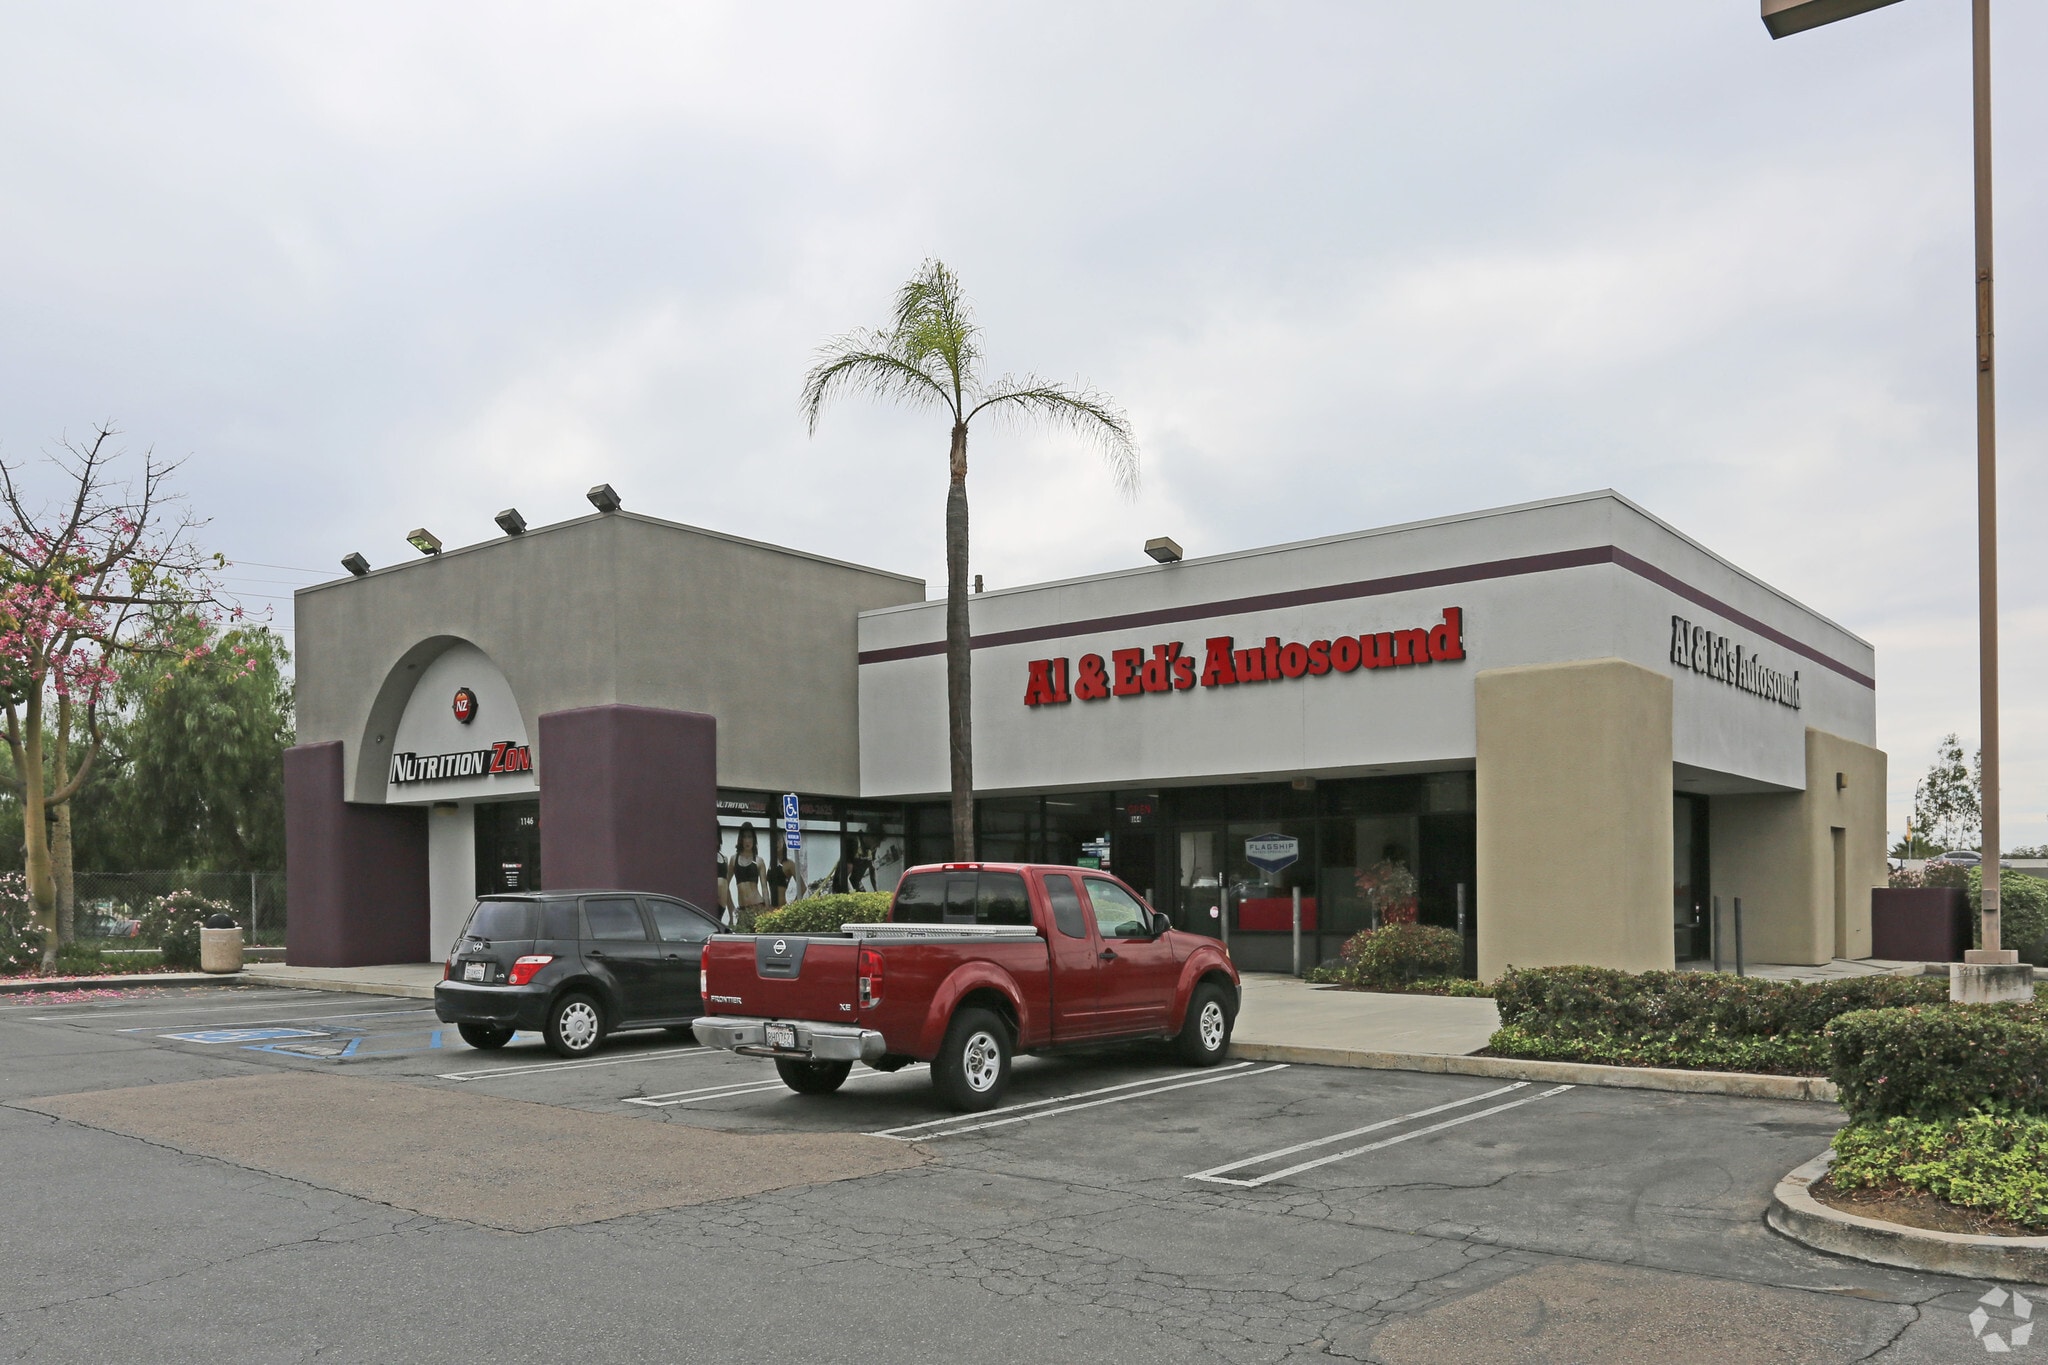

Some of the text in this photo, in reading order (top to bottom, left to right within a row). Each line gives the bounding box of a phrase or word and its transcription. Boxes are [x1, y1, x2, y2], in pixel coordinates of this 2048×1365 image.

[1024, 607, 1465, 706] Al & Ed's Autosound
[1670, 615, 1800, 711] Al & Ed's Autosound
[456, 700, 468, 712] NZ
[391, 742, 533, 782] NUTRITION ZON
[520, 817, 534, 825] 1146
[710, 995, 742, 1004] FRONTIER
[839, 1003, 851, 1011] XE
